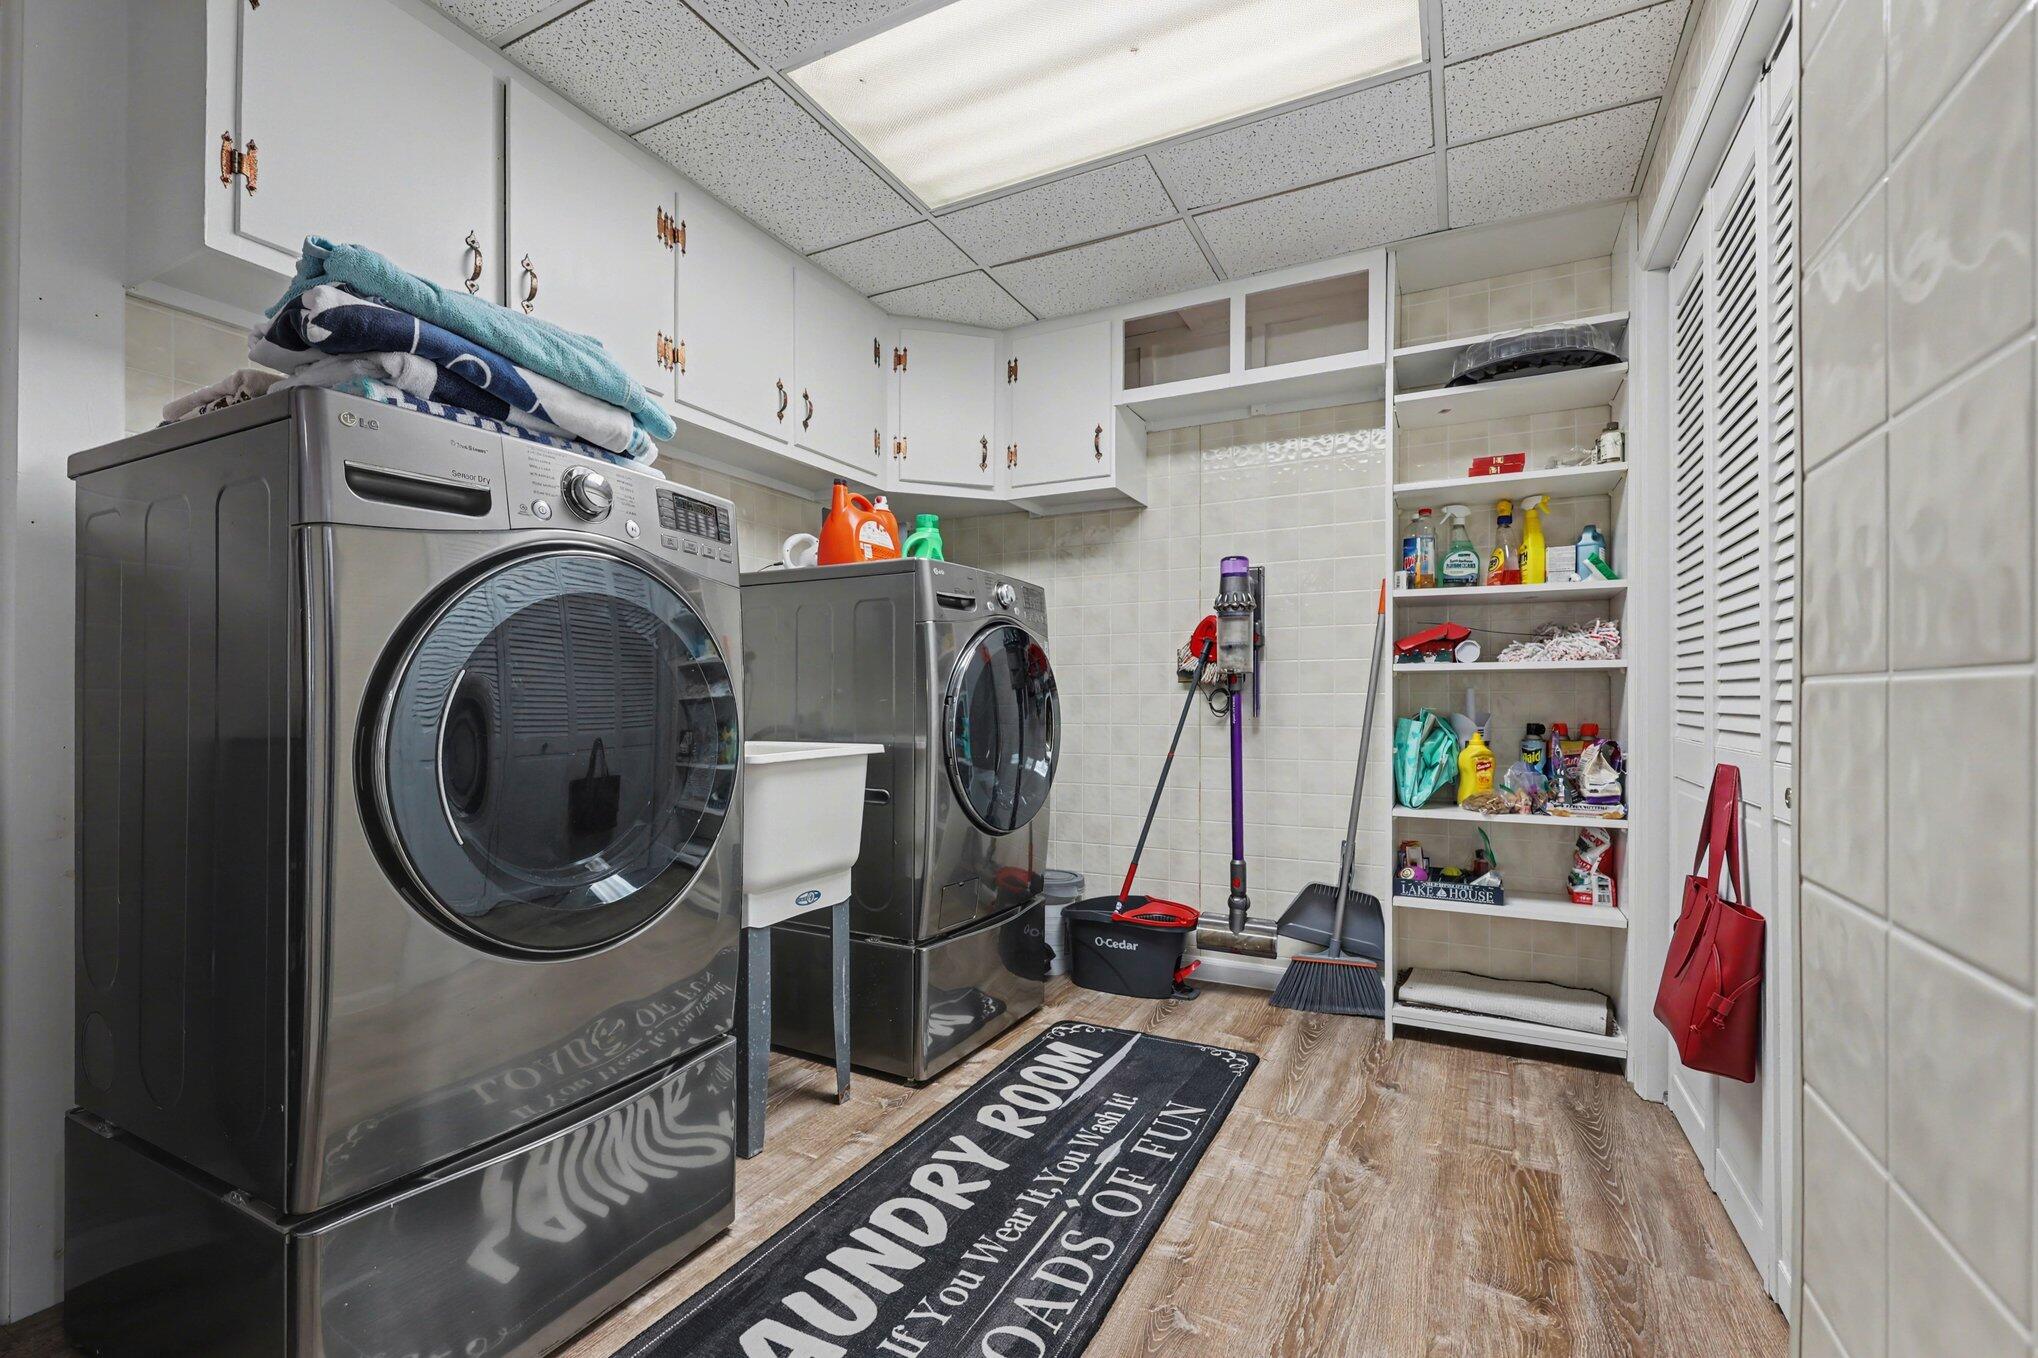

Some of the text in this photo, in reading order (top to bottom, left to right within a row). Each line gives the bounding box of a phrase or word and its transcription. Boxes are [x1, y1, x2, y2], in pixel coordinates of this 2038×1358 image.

[359, 417, 380, 431] LG
[451, 469, 491, 485] Sensor Dry
[1400, 883, 1434, 898] LAKE
[1449, 888, 1495, 903] HOUSE
[1094, 936, 1139, 951] O-Cedar
[739, 1135, 1010, 1358] AUNDRY
[976, 1041, 1104, 1140] ROOM
[875, 1093, 1139, 1358] If You Wear It, You Wash It!
[978, 1099, 1207, 1358] OADS OF FUN
